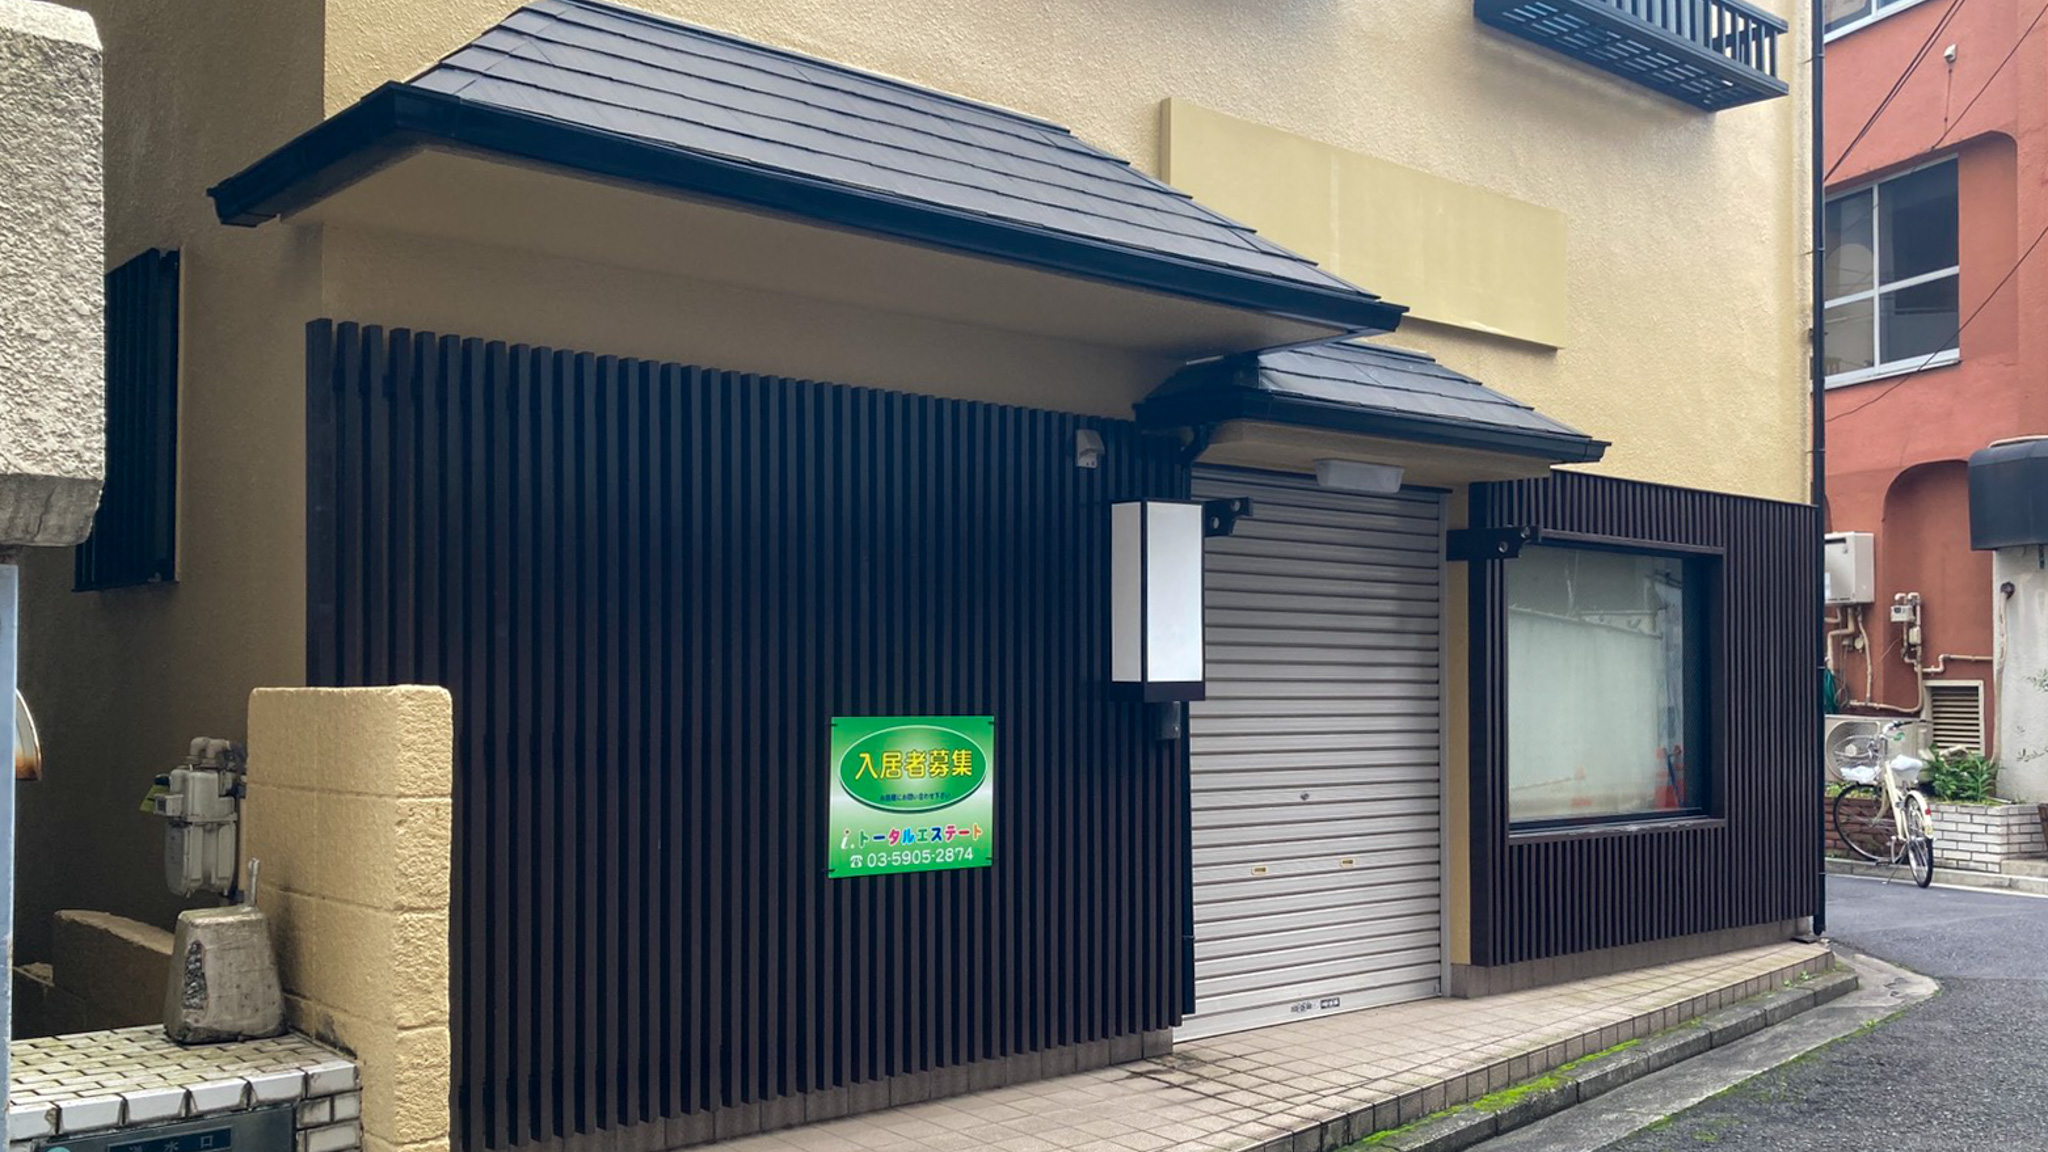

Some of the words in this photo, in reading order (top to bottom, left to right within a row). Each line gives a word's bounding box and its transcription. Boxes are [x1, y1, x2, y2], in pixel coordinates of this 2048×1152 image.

[855, 749, 973, 780] 入居者募集
